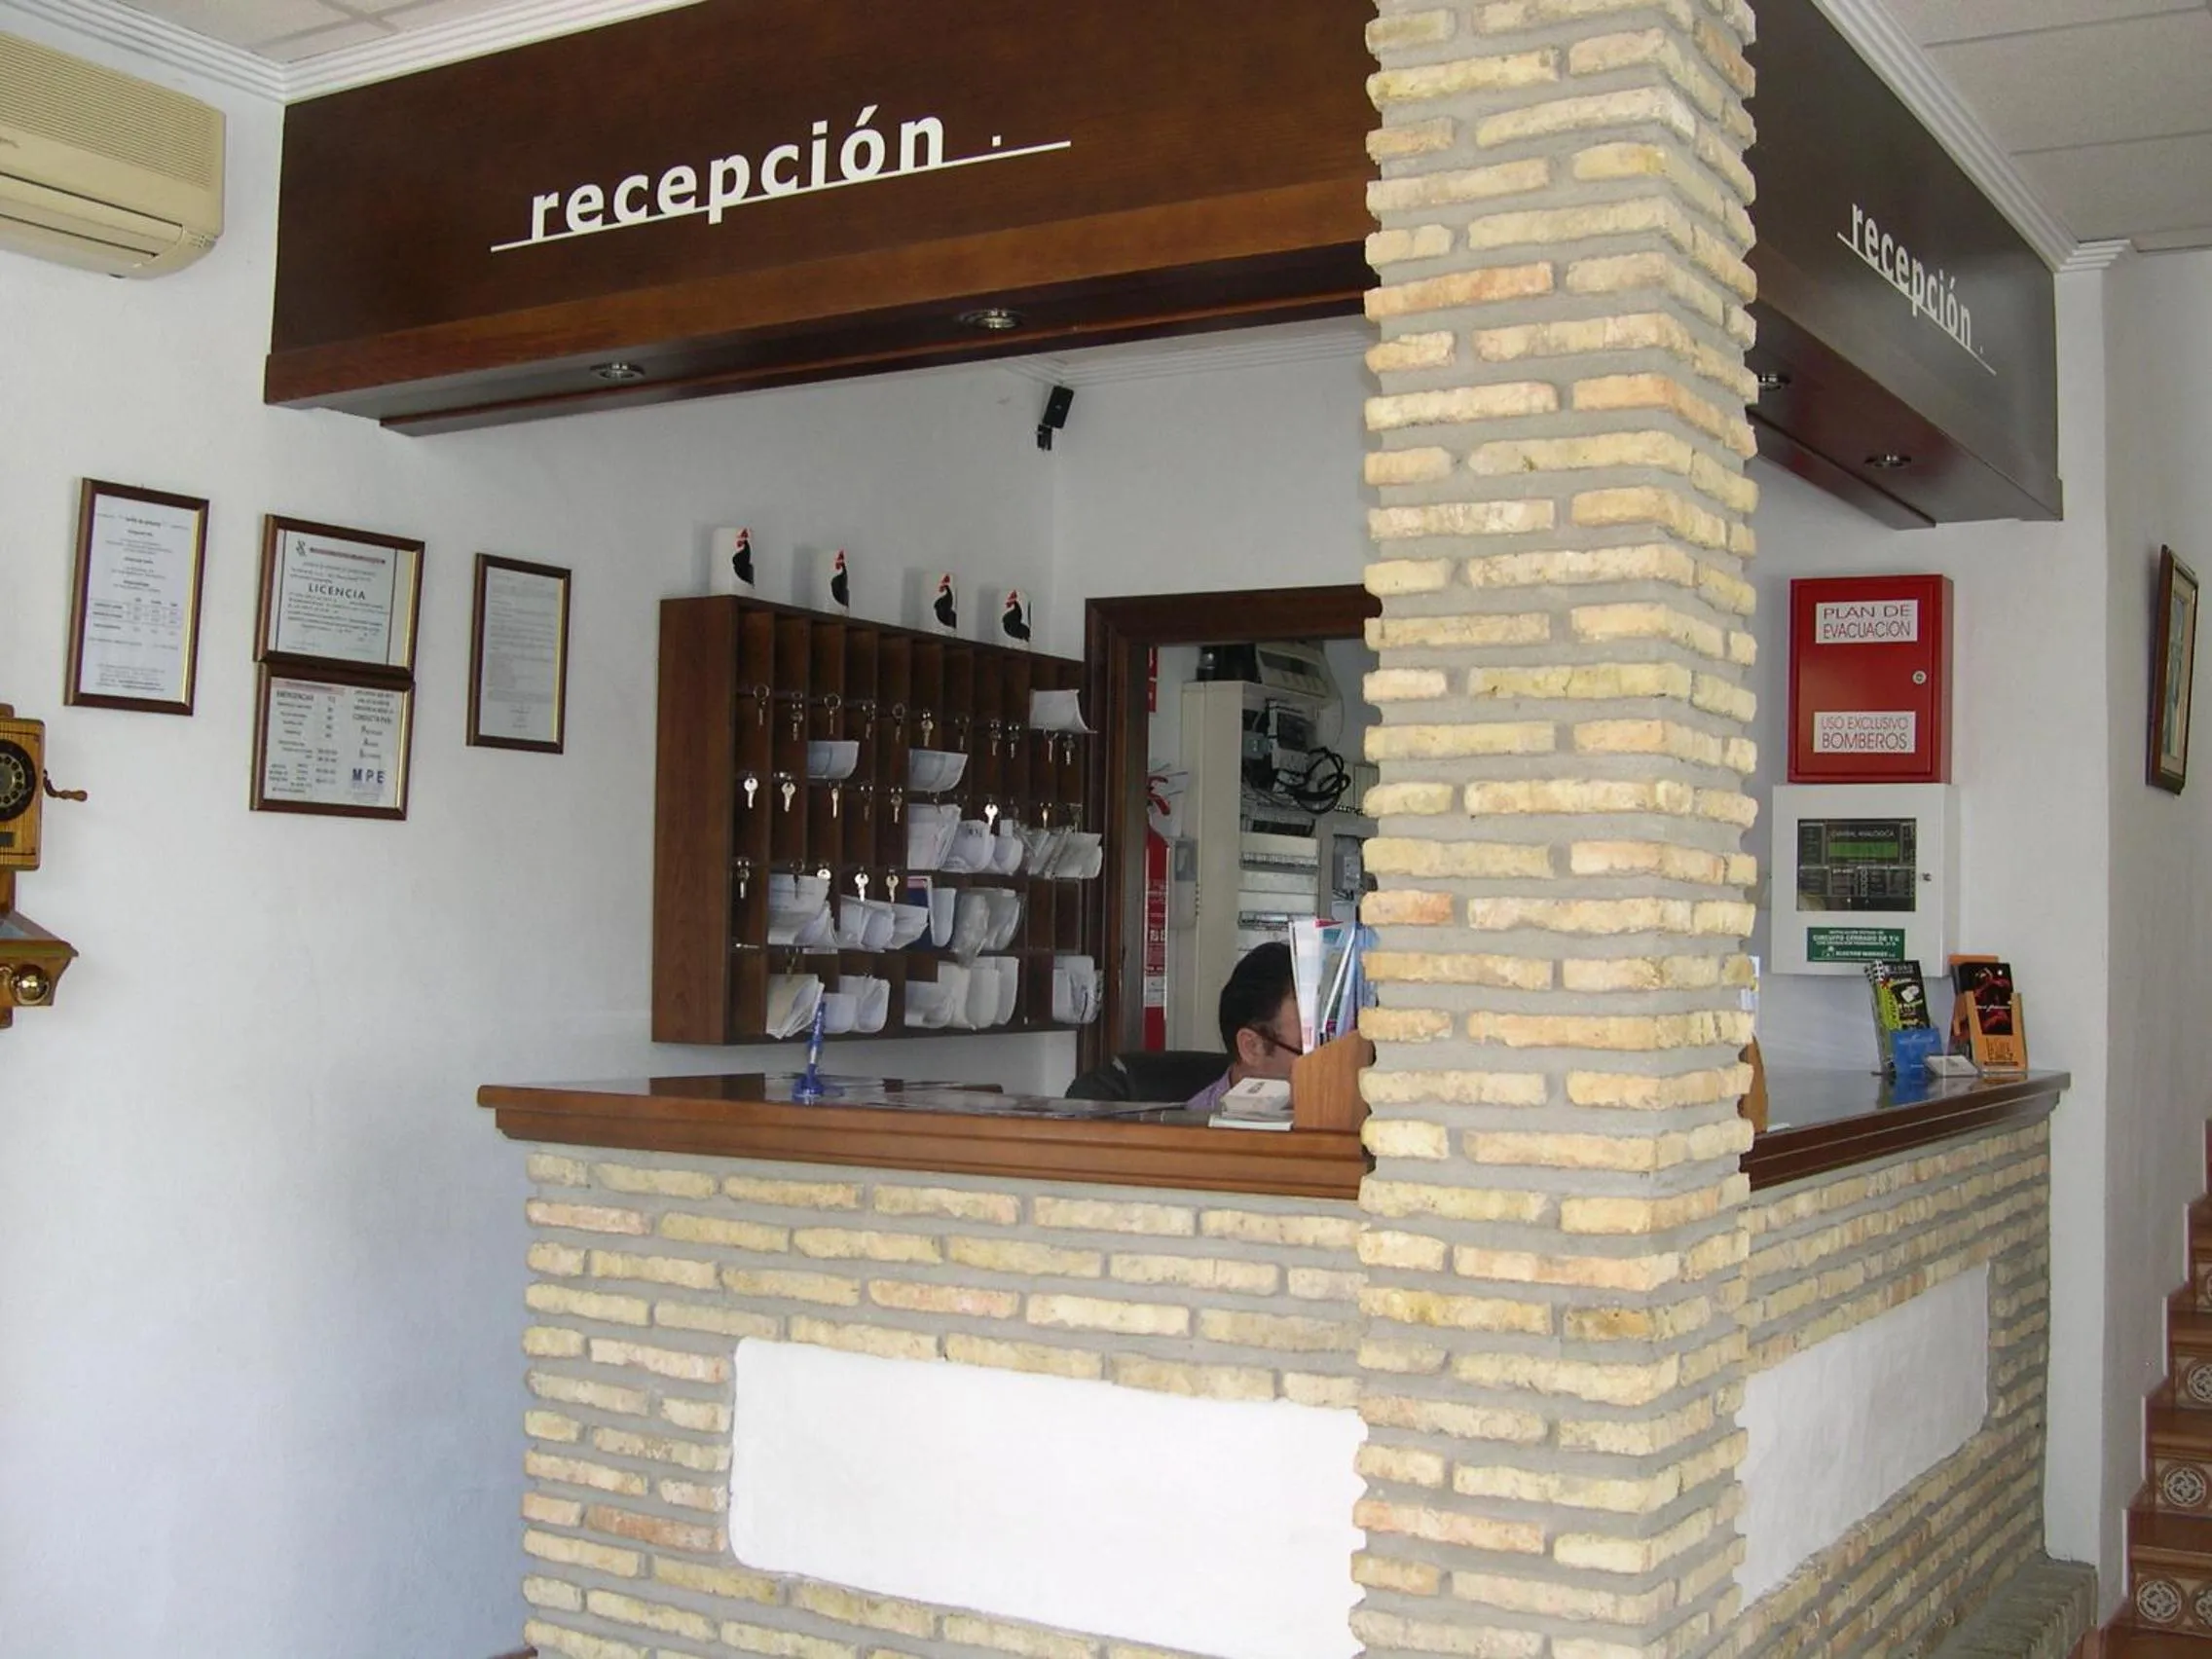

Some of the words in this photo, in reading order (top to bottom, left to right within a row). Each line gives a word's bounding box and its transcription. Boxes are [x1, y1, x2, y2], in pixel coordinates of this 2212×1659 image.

[531, 104, 944, 241] recepción
[1852, 203, 1972, 351] recepción
[308, 583, 367, 601] LICENCIA
[1823, 606, 1875, 620] PLAN
[1883, 604, 1911, 618] DE
[1821, 716, 1843, 730] USO
[1847, 716, 1909, 730] EXCLUSIVO
[1822, 732, 1908, 751] BOMBEROS
